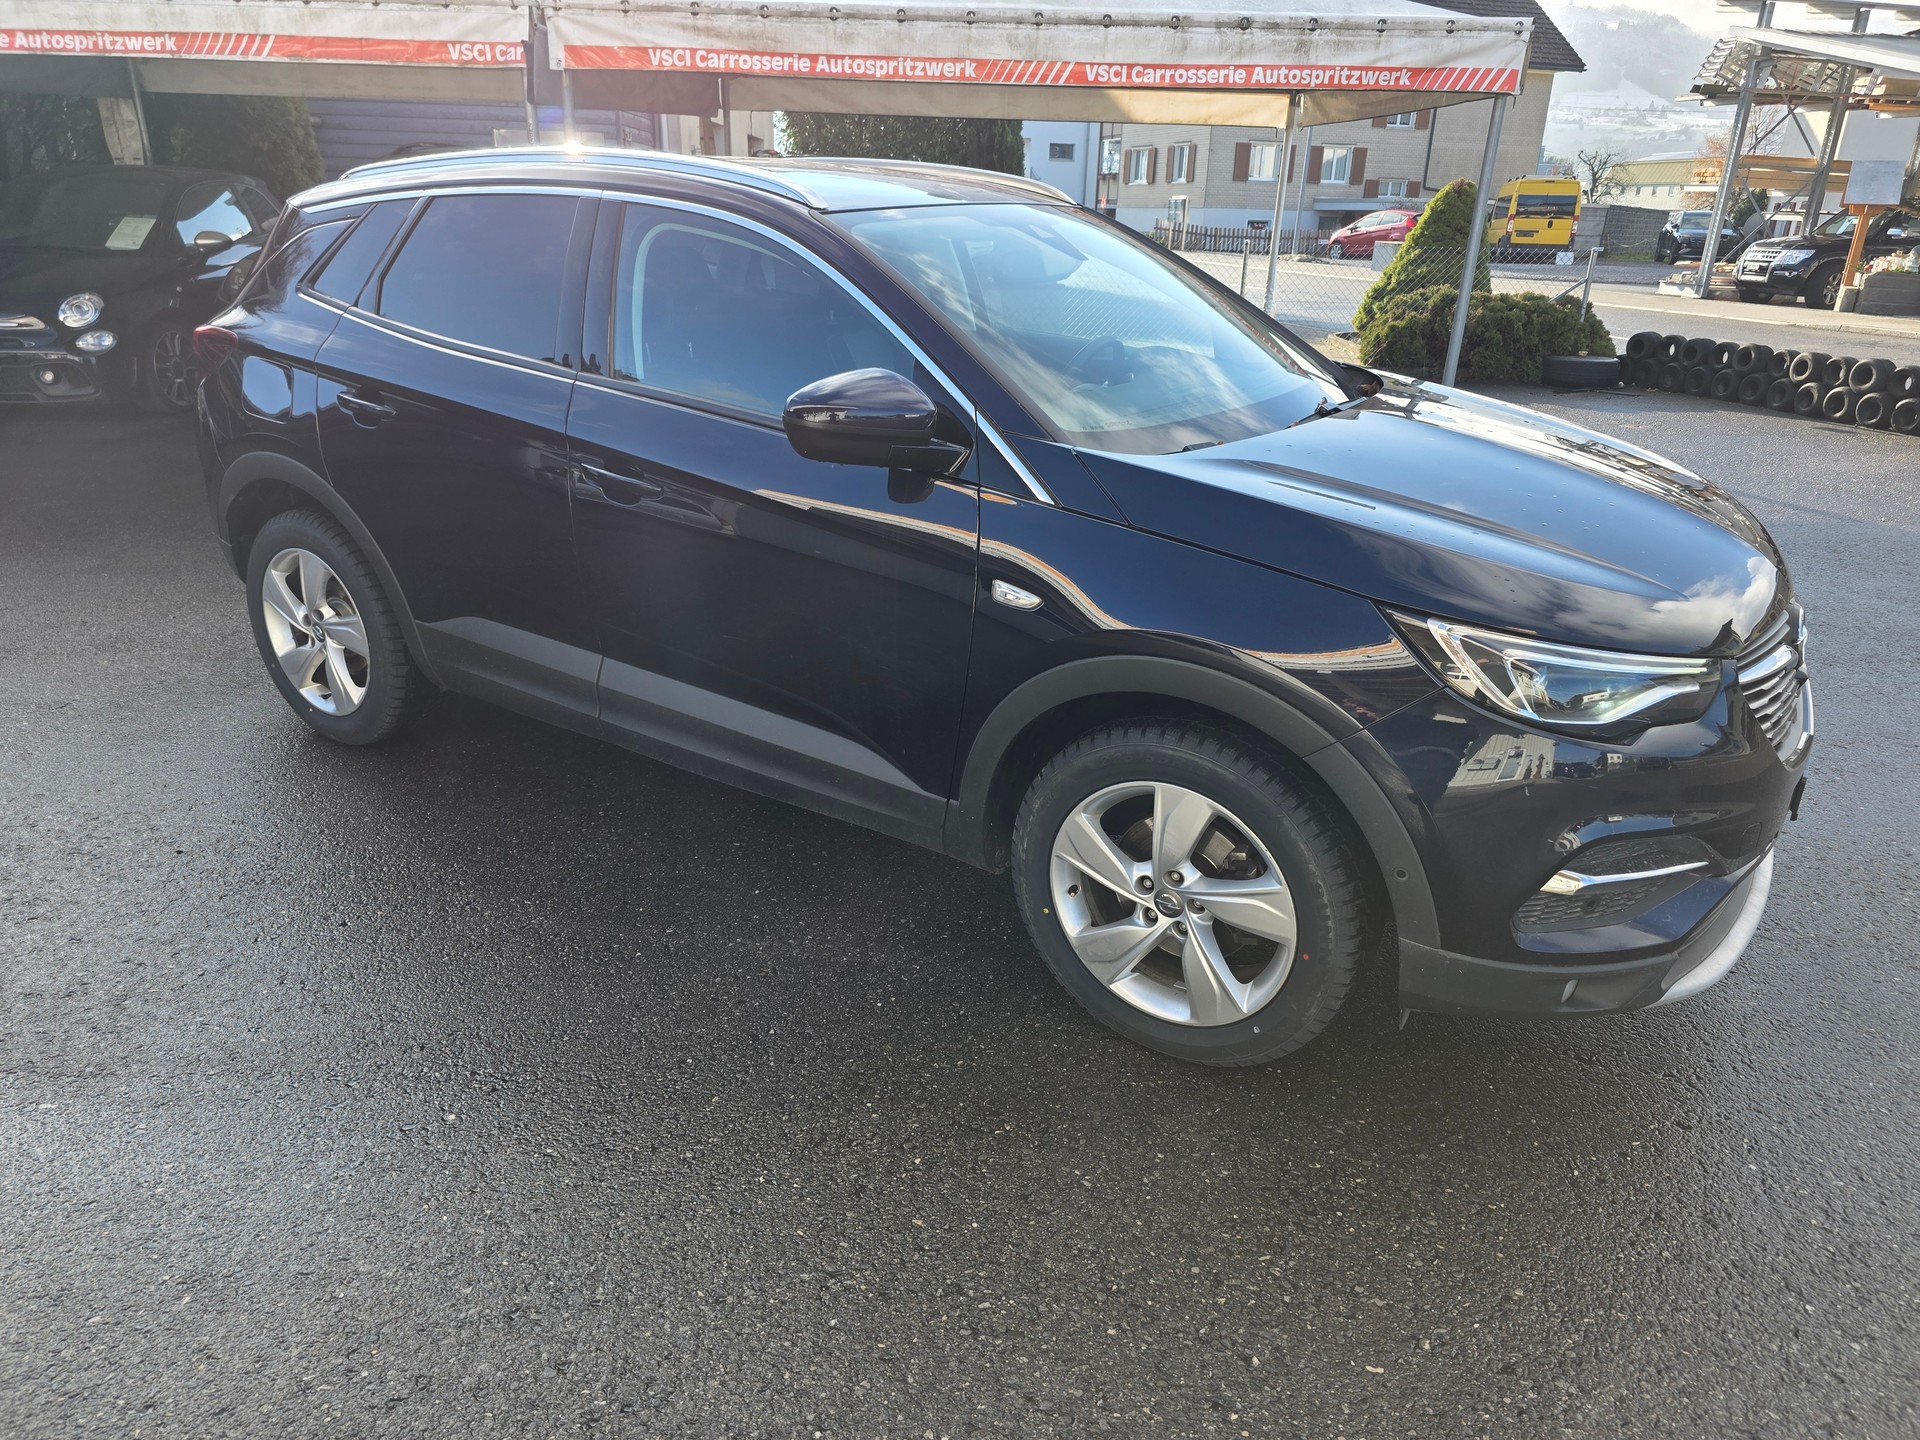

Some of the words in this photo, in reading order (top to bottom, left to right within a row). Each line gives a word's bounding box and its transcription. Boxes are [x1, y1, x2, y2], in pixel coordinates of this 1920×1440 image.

[15, 31, 178, 52] Autospritzwerk
[447, 43, 492, 61] VSCI
[648, 49, 691, 67] VSCI
[695, 50, 811, 72] Carrosserie
[816, 55, 977, 78] Autospritzwerk
[1085, 64, 1127, 82] VSCI
[1131, 65, 1247, 84] Carrosserie
[1251, 66, 1413, 87] Autospritzwerk
